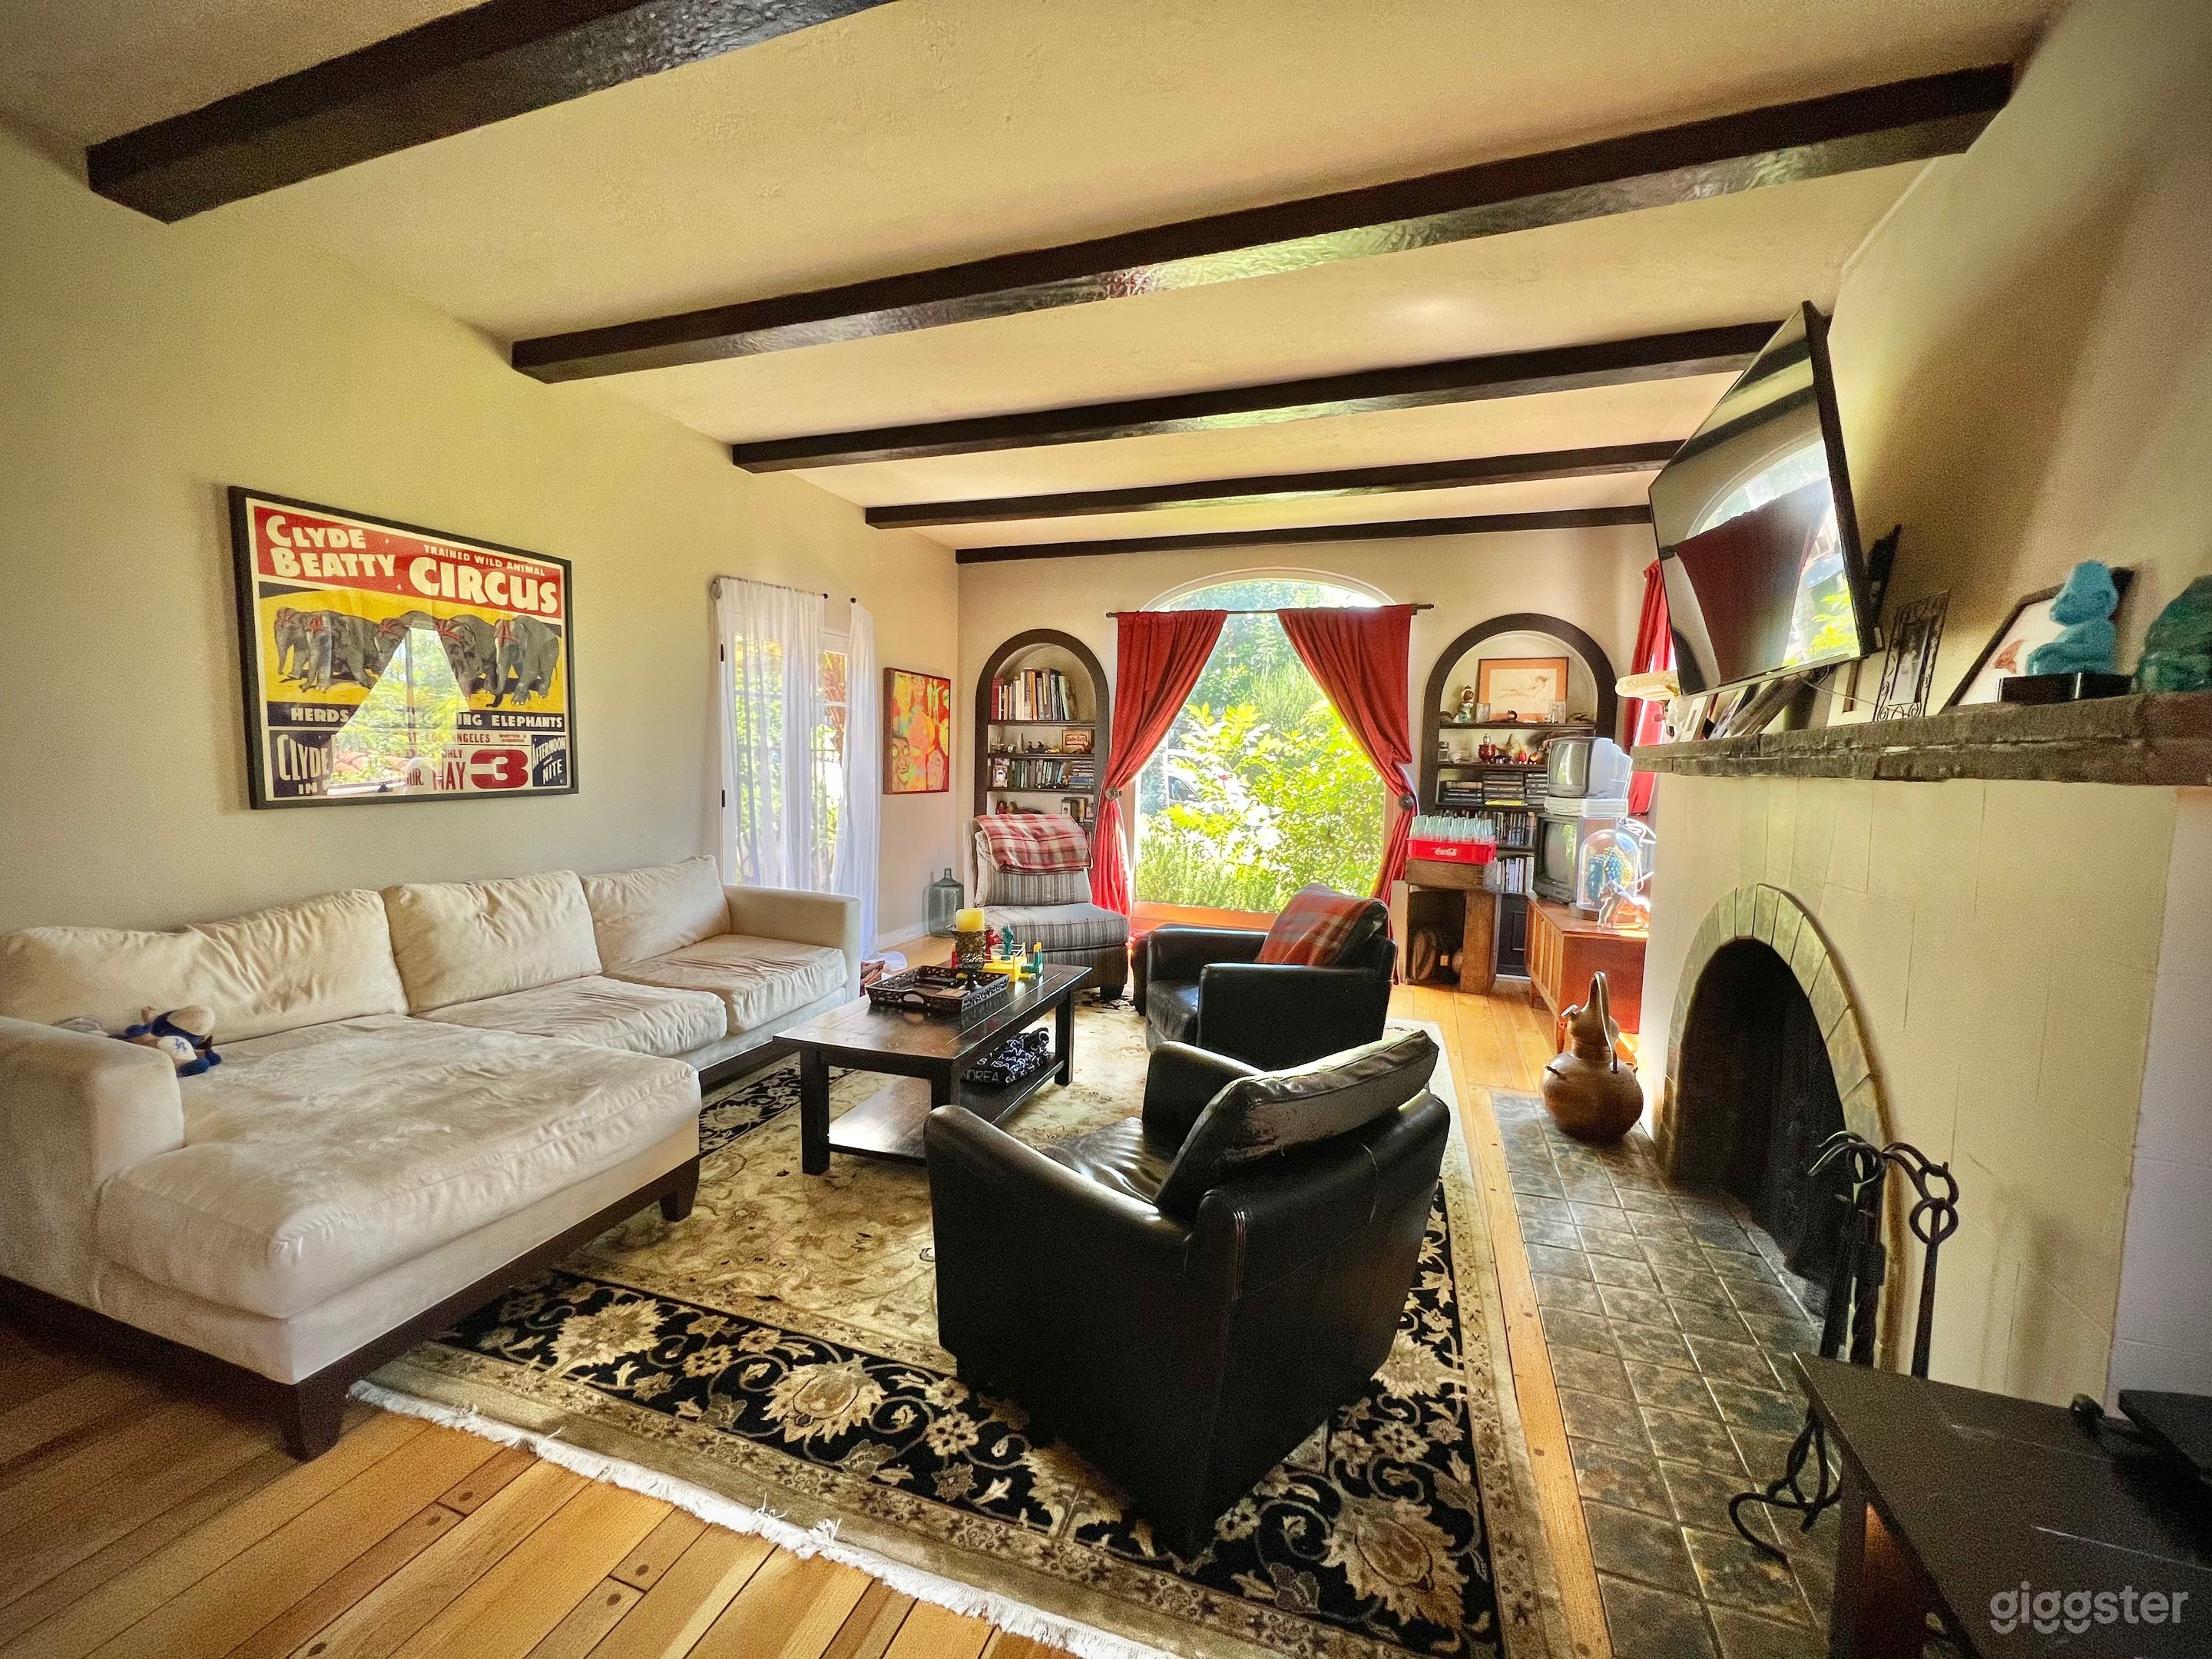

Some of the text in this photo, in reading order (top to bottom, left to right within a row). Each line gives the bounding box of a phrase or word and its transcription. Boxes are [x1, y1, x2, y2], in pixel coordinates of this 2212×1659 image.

[265, 515, 366, 548] CLYDE
[270, 546, 396, 578] BEATTY
[423, 544, 545, 576] TRAINED WILD ANIMAL
[409, 556, 558, 614] CIRCUS
[290, 707, 349, 723] HERDS
[492, 714, 563, 728] ELEPHANTS
[452, 732, 491, 743] NGELES
[532, 737, 566, 770] AFTERNOON
[276, 733, 329, 782] CLYDE
[432, 761, 466, 790] MAY
[470, 749, 529, 790] 3
[542, 758, 563, 785] NITE
[298, 782, 318, 795] IN
[961, 1068, 999, 1083] NDREA
